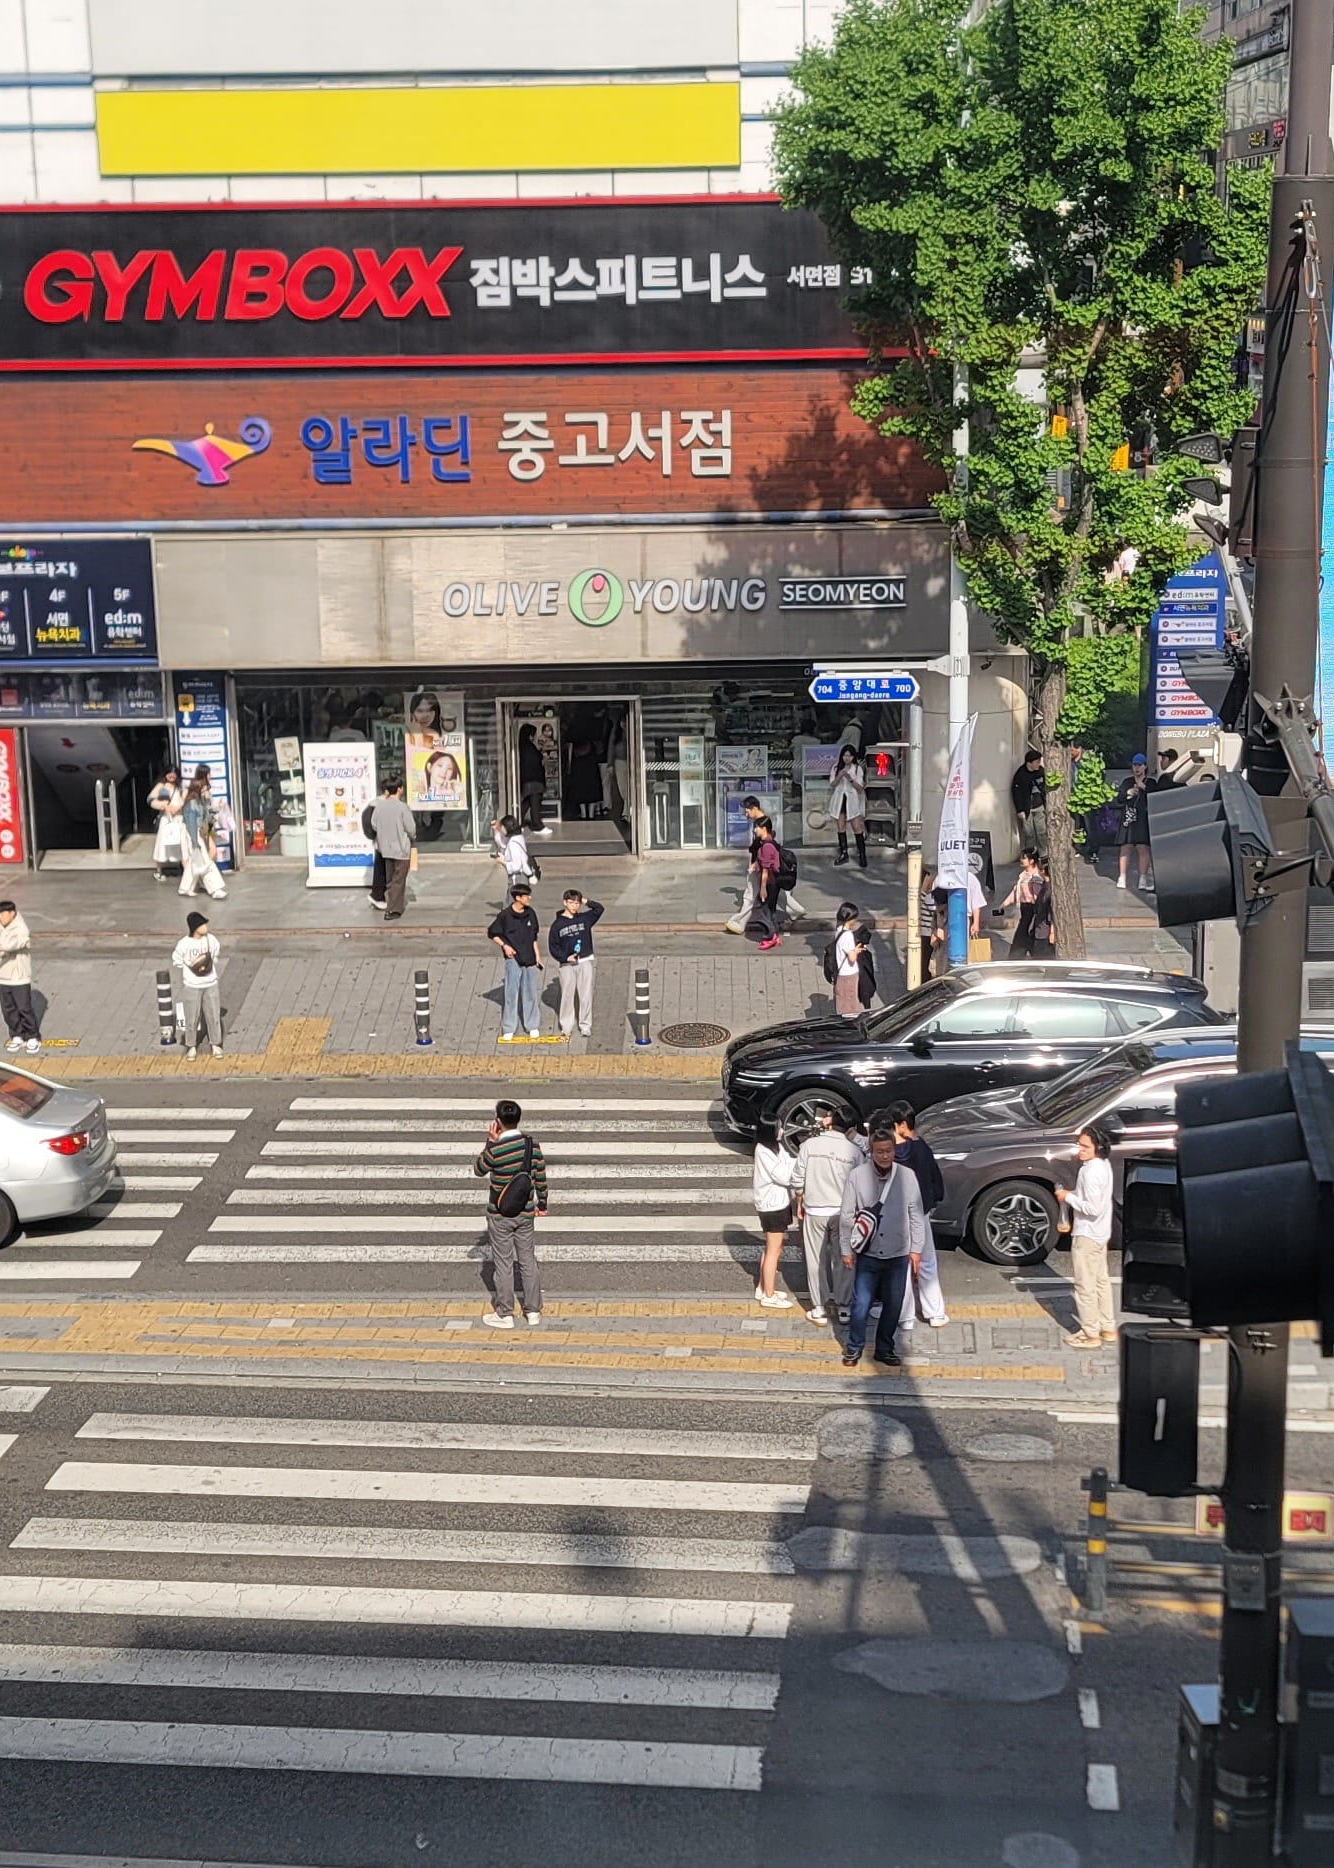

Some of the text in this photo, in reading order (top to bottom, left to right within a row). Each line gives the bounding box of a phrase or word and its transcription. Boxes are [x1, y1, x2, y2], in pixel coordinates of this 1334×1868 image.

[469, 253, 767, 307] 짐박스피트니스
[787, 263, 842, 287] 서면점
[24, 247, 464, 323] GYMBOXX
[299, 409, 732, 484] 알라딘 중고서점
[49, 588, 67, 602] 4F
[113, 587, 131, 600] 5F
[443, 578, 767, 617] OLIVE YOUNG
[781, 583, 906, 602] SEOMYEON
[46, 612, 70, 626] 서면
[104, 608, 143, 625] ed:m
[35, 626, 81, 643] 뉴욕치과
[817, 685, 833, 694] 704
[838, 680, 890, 691] 중앙대로
[895, 684, 911, 693] 700
